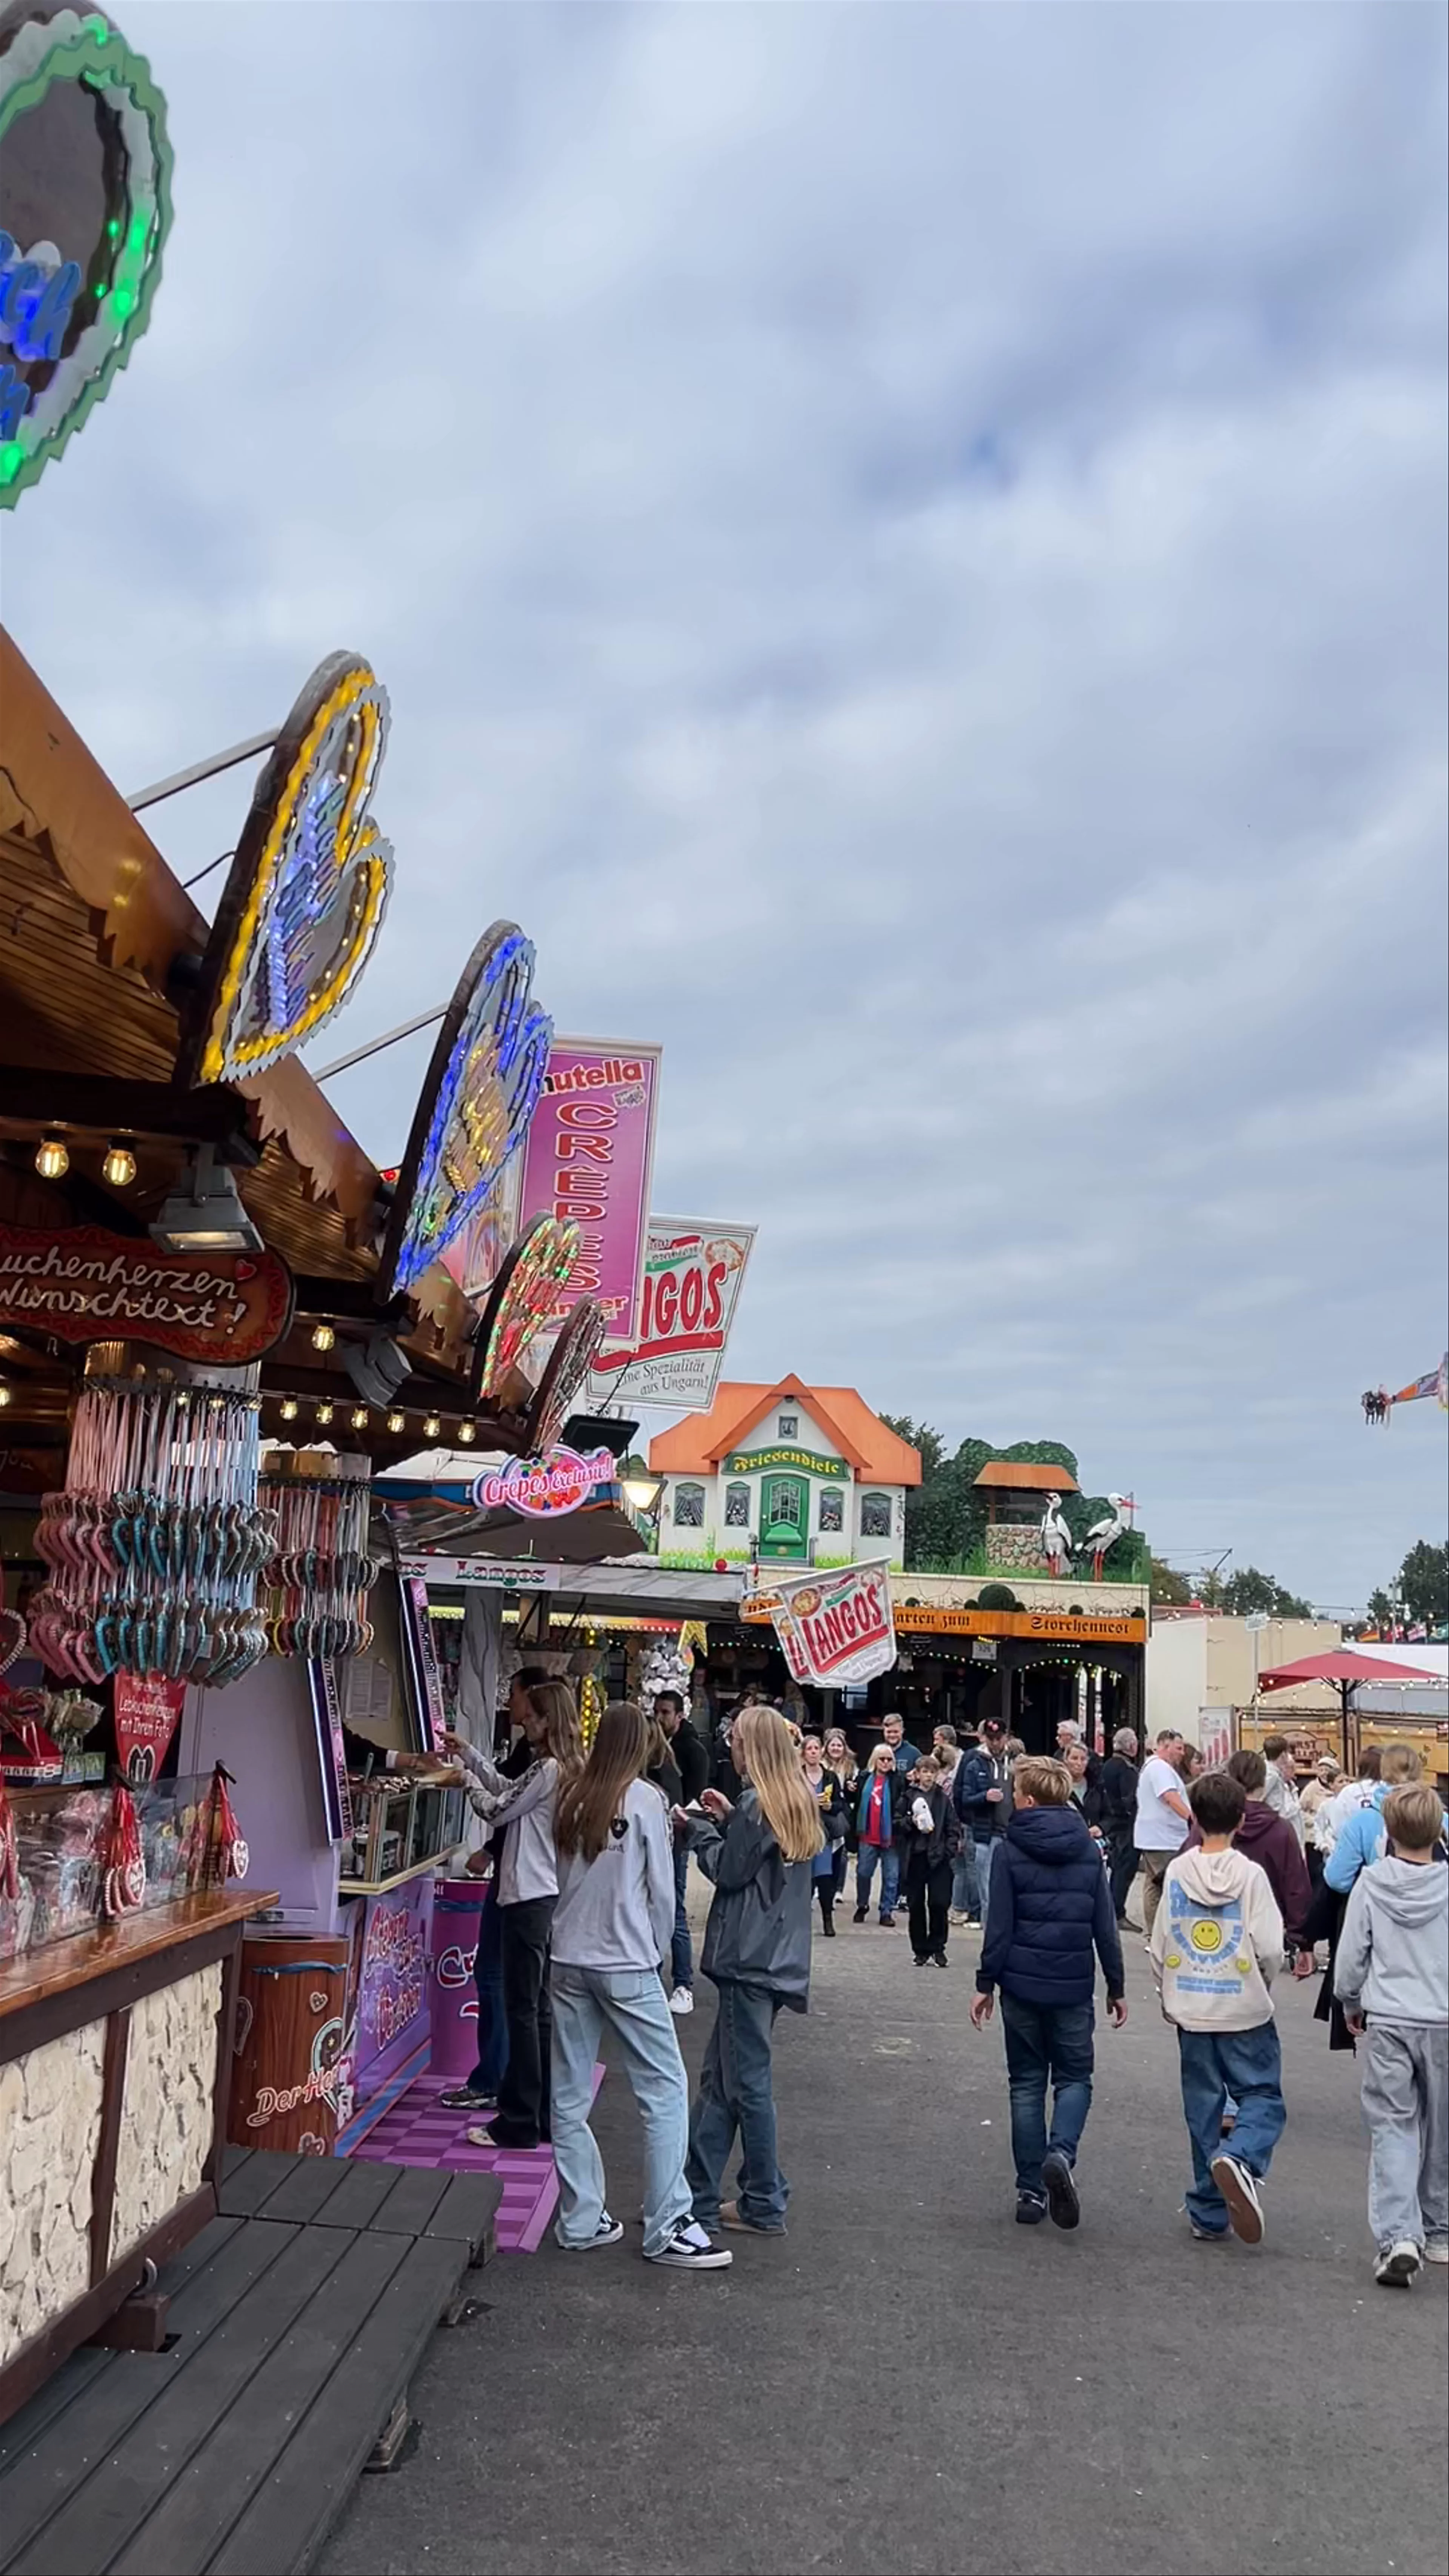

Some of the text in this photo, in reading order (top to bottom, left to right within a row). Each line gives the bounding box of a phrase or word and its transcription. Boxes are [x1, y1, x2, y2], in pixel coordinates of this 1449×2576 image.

[541, 1060, 644, 1093] nutella
[642, 1358, 705, 1380] Spezialität
[640, 1374, 709, 1396] aus Ungarn!
[733, 1449, 840, 1474] Friesendiele
[456, 1561, 546, 1587] Langos
[801, 1583, 883, 1669] LANGOS
[942, 1614, 970, 1629] zum
[1031, 1616, 1129, 1634] Storchennest
[246, 2086, 302, 2127] Der
